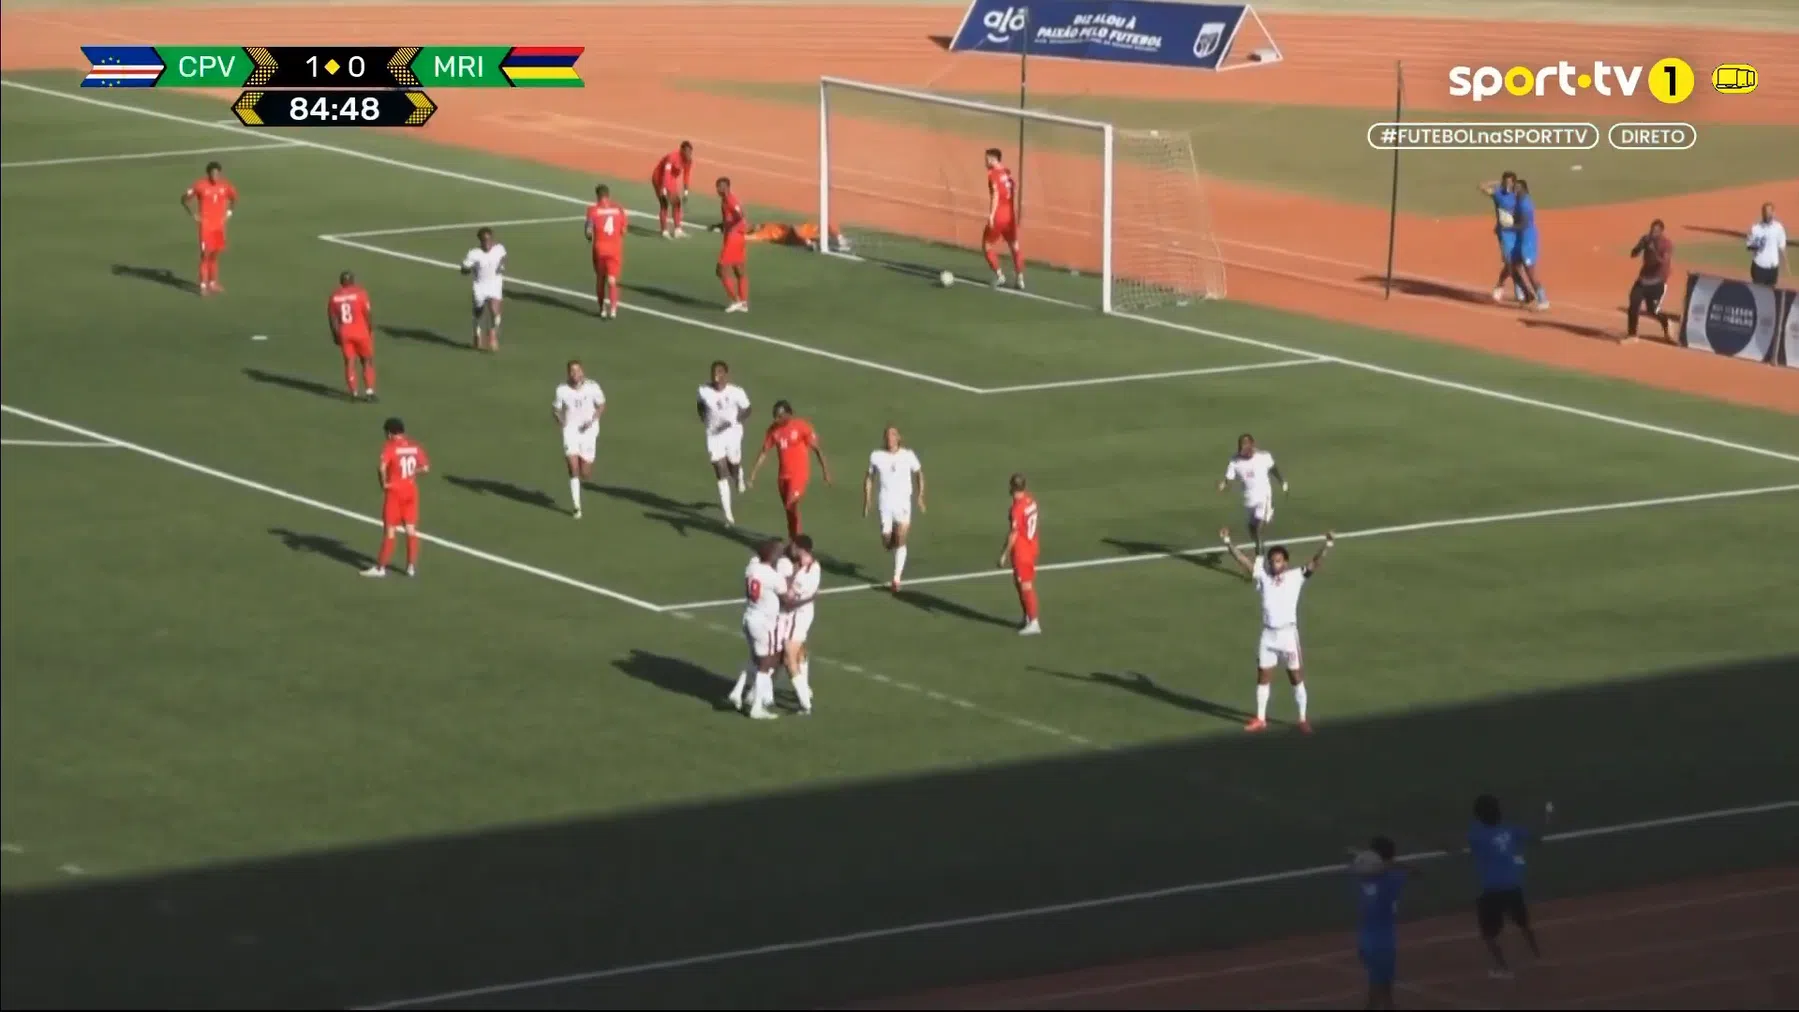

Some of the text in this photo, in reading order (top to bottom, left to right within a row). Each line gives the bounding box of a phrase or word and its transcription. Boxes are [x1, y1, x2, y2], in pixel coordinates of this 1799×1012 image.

[1109, 29, 1163, 48] FUTEBOL
[603, 215, 614, 236] 4
[341, 302, 353, 324] 8
[400, 455, 417, 479] 10
